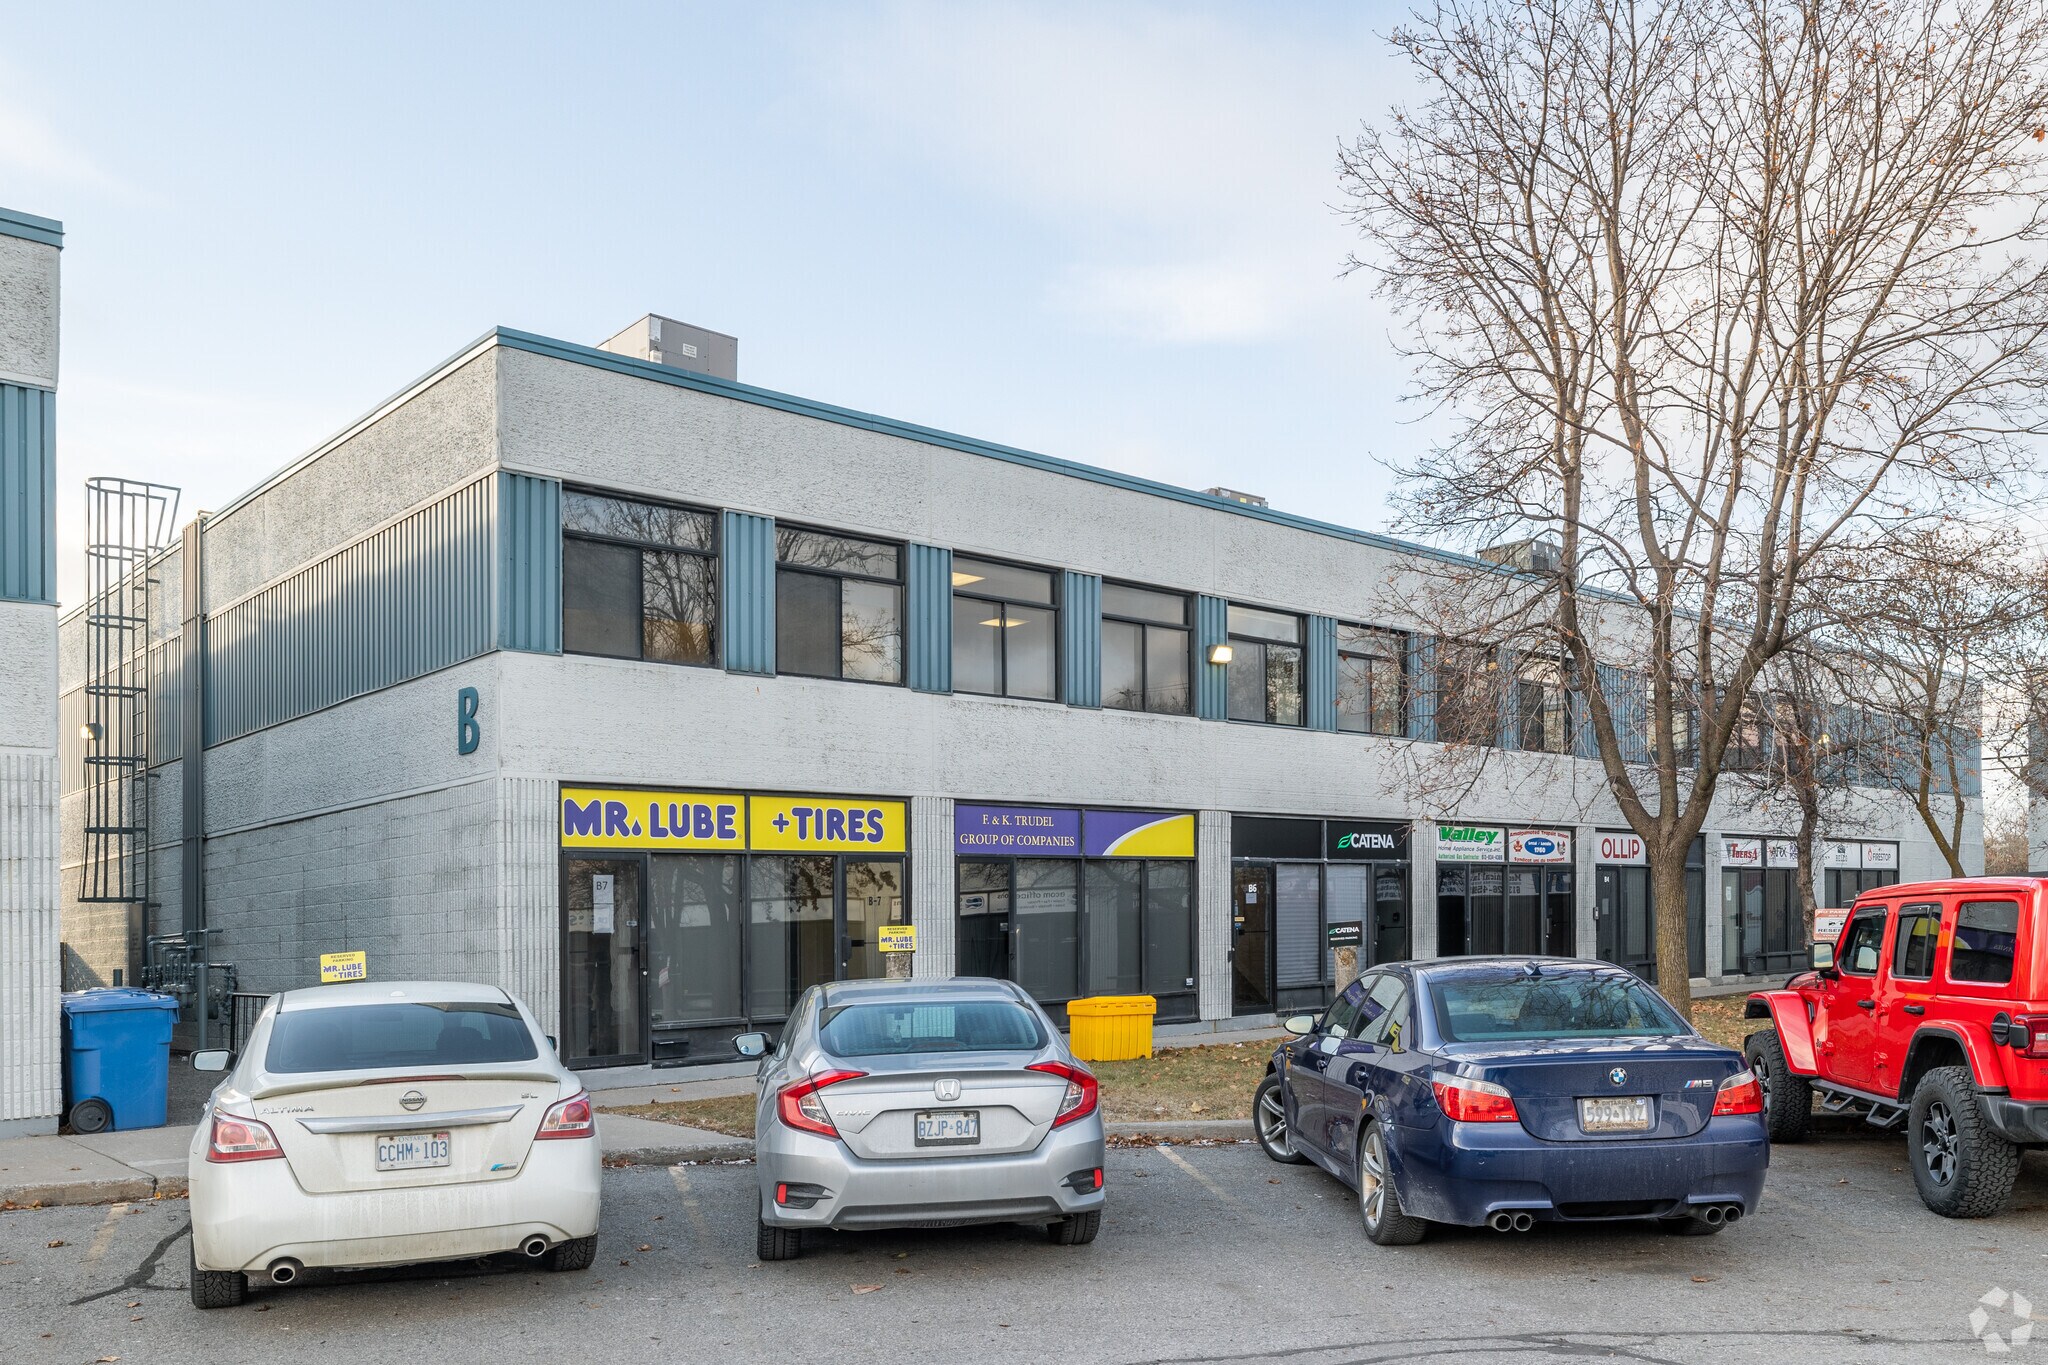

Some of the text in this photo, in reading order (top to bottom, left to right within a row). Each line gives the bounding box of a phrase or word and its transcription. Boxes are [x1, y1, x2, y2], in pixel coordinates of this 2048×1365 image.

[458, 687, 480, 755] B
[564, 798, 737, 840] MR. LUBE
[772, 807, 884, 843] +TIRES
[982, 814, 1054, 827] F. & K. TRUDEL
[960, 833, 1075, 847] GROUP OF COMPANIES
[1351, 833, 1394, 849] CATENA
[1438, 826, 1499, 845] Valley
[1602, 837, 1640, 859] OLLIP
[596, 881, 608, 891] B7
[1248, 883, 1257, 893] B6
[868, 896, 882, 906] B-7
[1335, 926, 1360, 934] CATENA
[323, 962, 363, 973] MR. LUBE
[1694, 1079, 1713, 1088] M5
[260, 1104, 315, 1115] ALTIMA
[918, 1119, 978, 1137] BZJP 847
[398, 1135, 428, 1143] ONTARIO
[379, 1141, 448, 1162] CCHM 103
